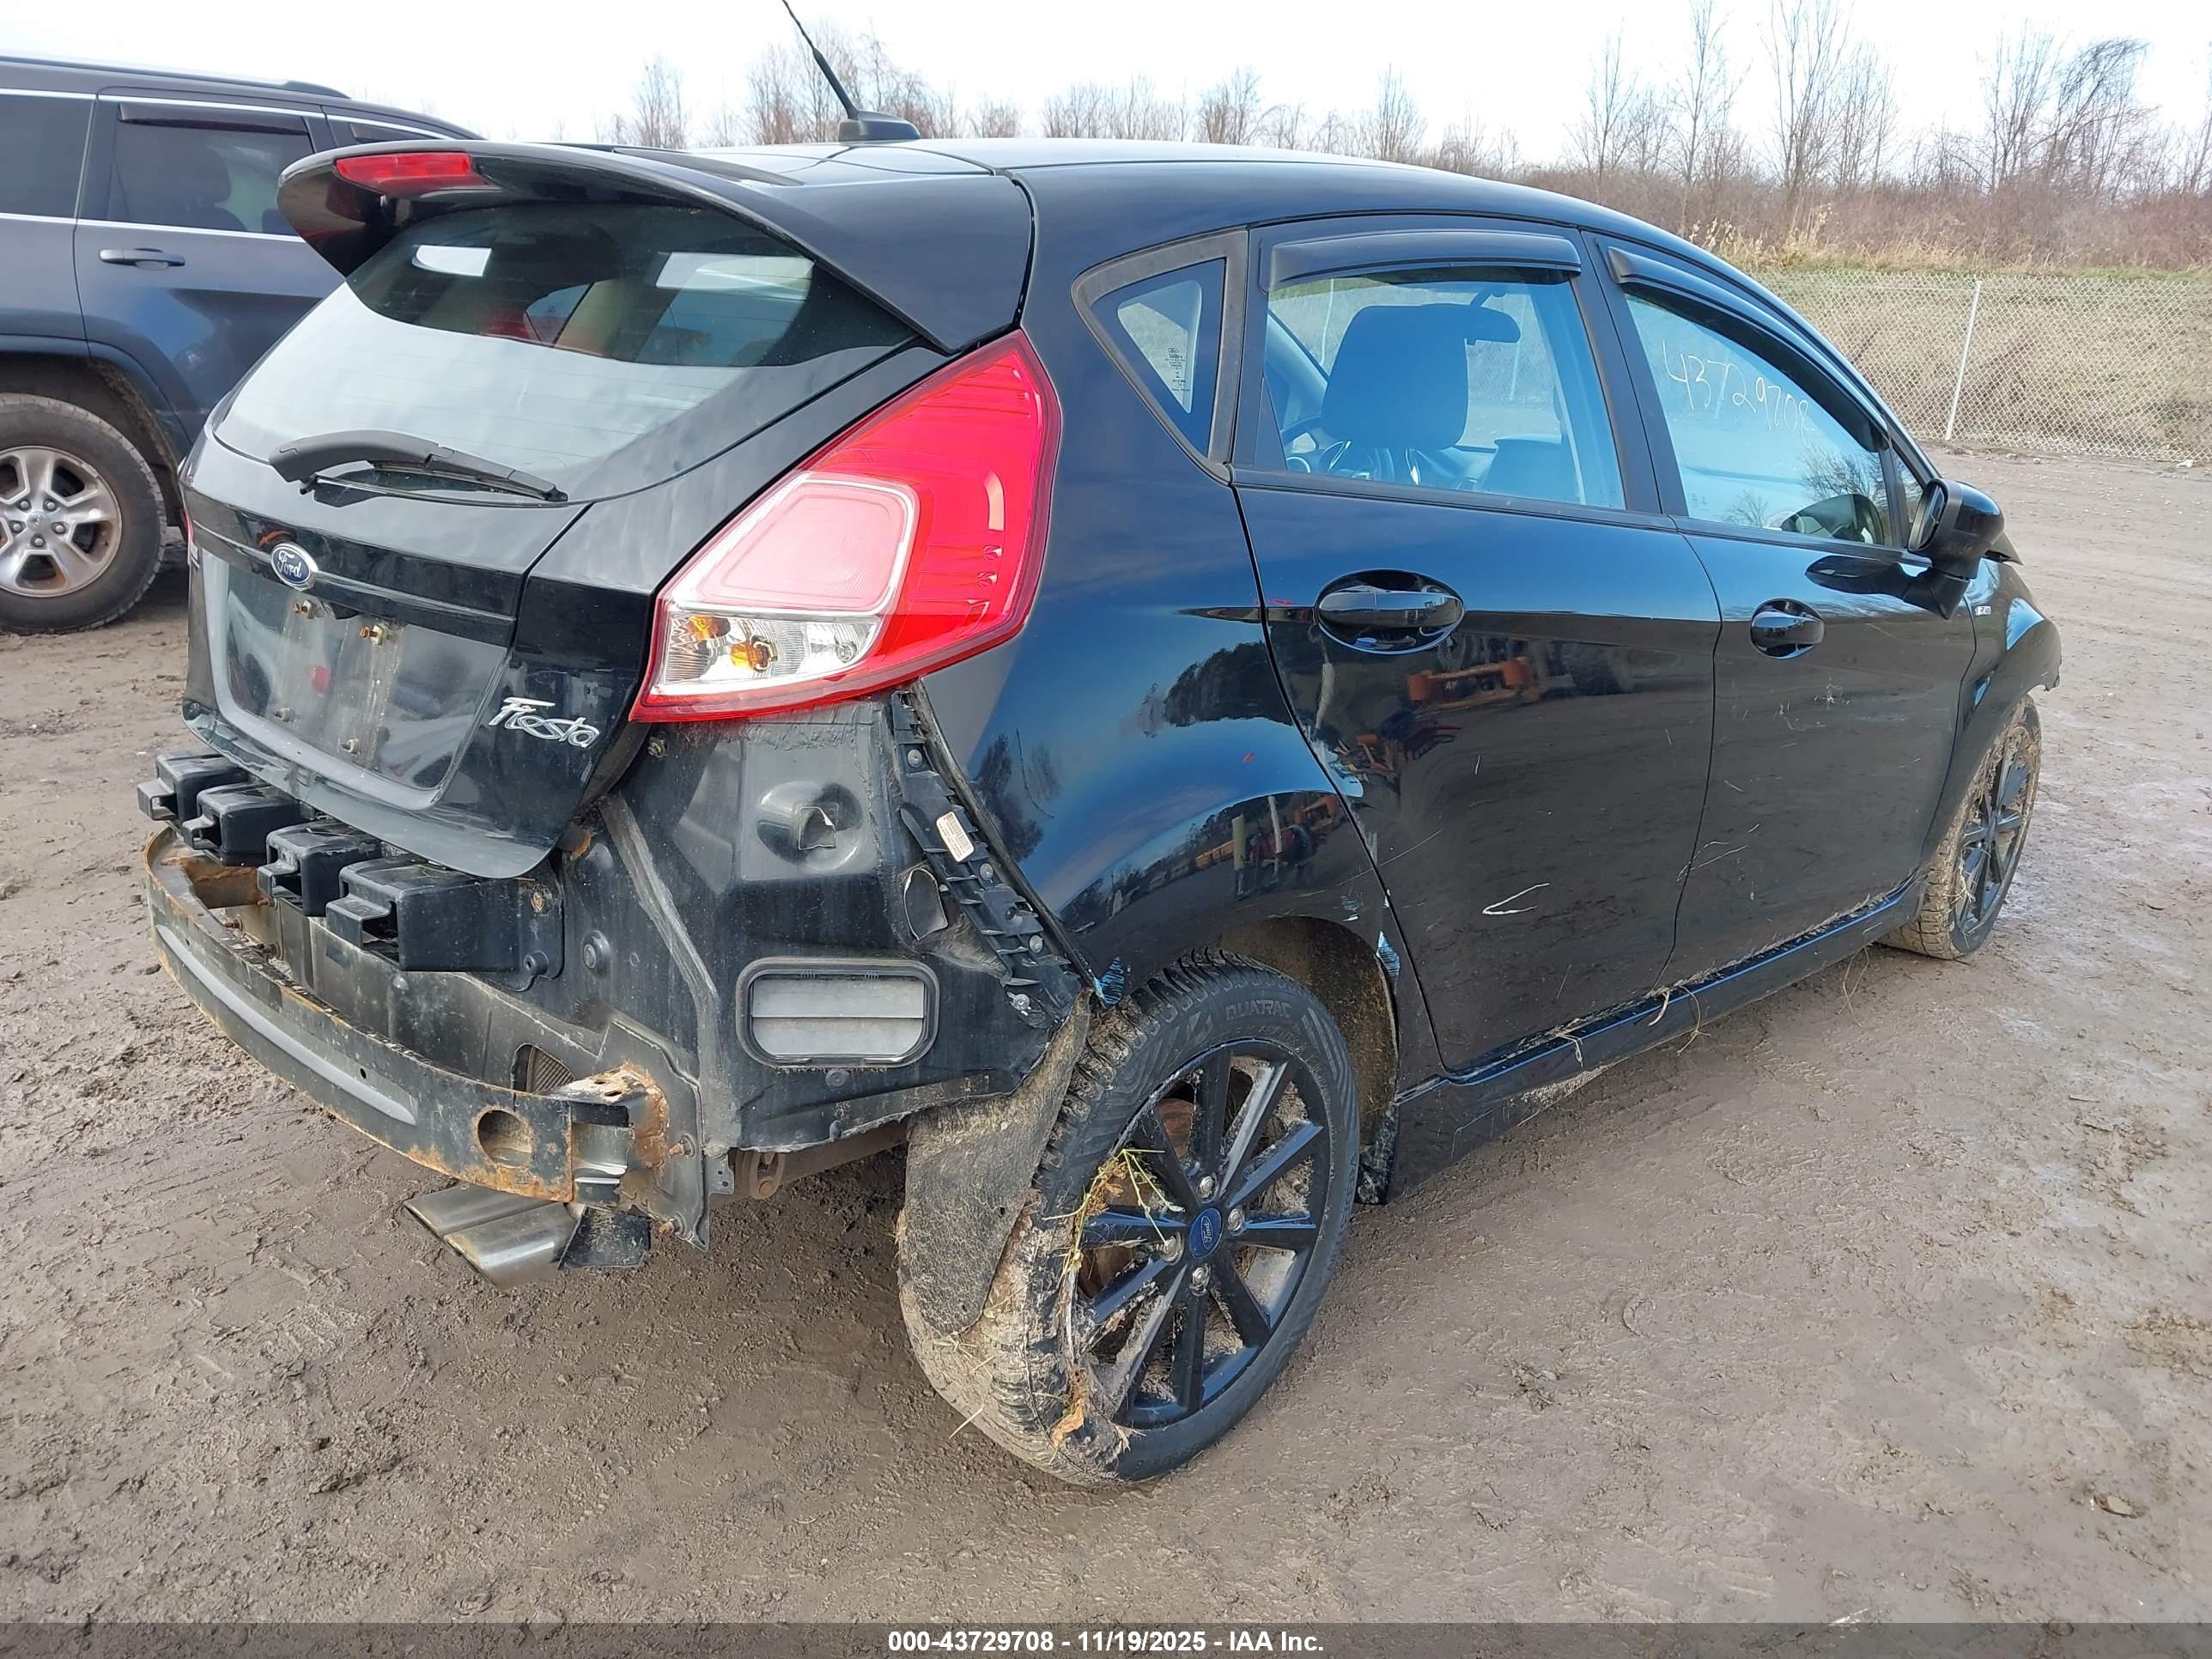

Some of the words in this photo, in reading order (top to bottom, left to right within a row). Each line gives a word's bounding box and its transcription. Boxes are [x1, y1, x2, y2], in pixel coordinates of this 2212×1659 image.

[1662, 338, 1816, 448] 43729708
[488, 696, 600, 749] Fiesta
[1225, 999, 1292, 1021] QUATRAC
